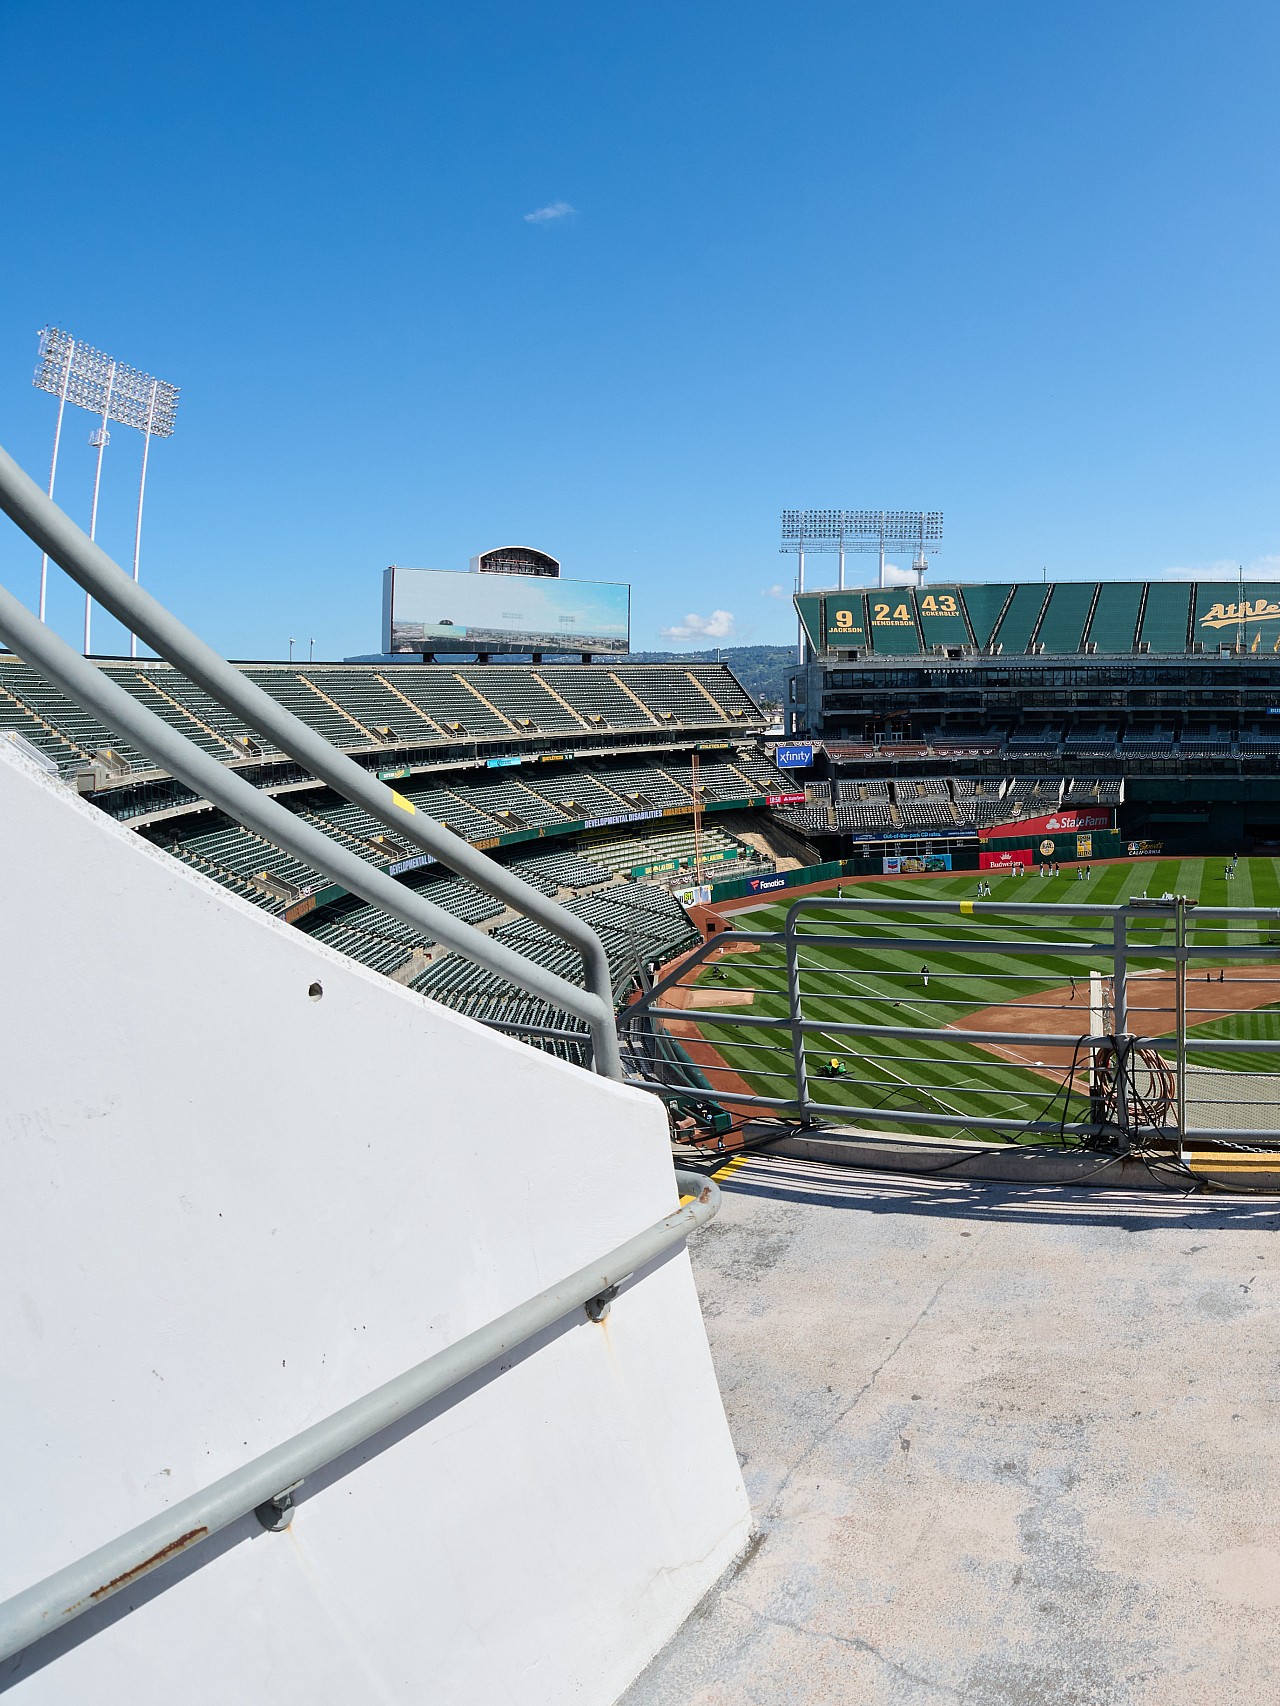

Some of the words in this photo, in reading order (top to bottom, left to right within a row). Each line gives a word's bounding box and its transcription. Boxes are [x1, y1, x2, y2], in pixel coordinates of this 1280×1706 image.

[921, 595, 957, 611] 43
[835, 610, 853, 628] 9
[874, 604, 911, 621] 24
[780, 751, 811, 763] xfinity
[584, 814, 628, 829] DEVELOPMENTAL
[628, 809, 663, 821] DISABILITIES
[1139, 841, 1165, 850] Sports
[389, 855, 427, 877] DEVELOPMENTAL
[760, 878, 785, 890] Fanatics
